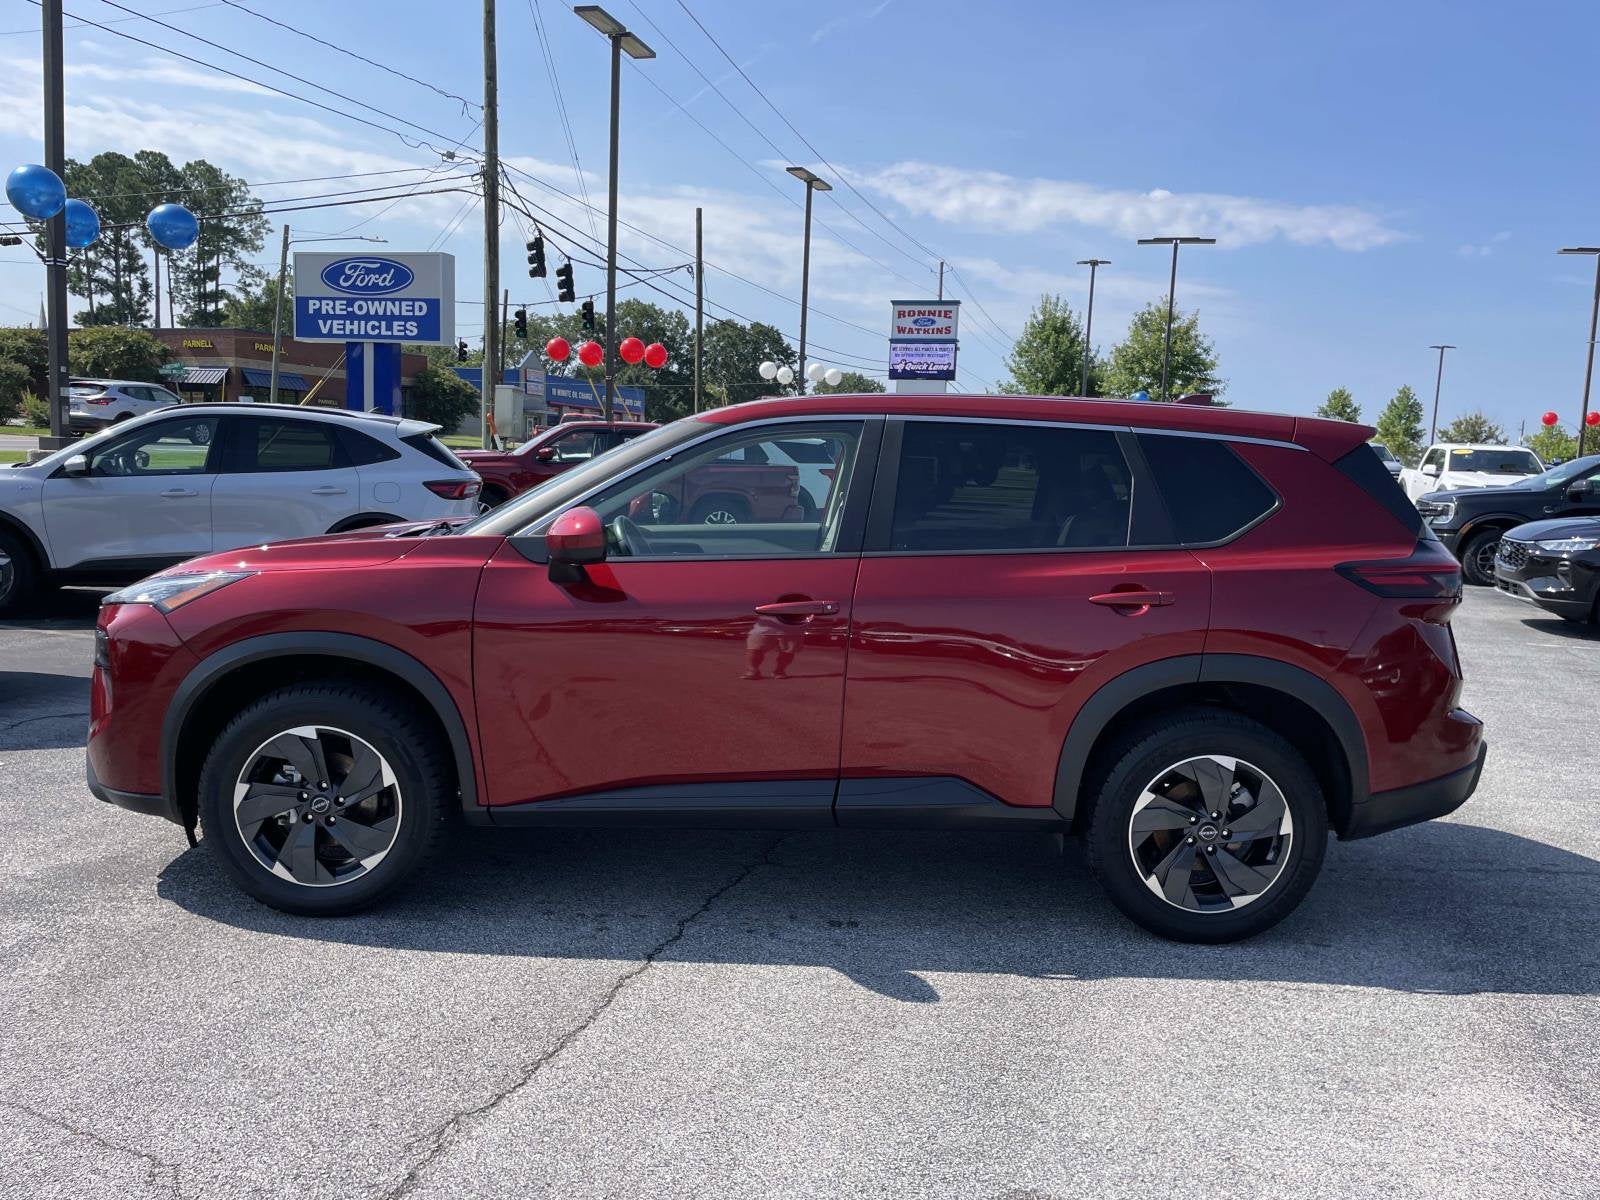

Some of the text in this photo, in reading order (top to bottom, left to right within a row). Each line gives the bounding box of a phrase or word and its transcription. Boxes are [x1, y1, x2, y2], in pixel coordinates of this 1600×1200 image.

[339, 262, 395, 287] Ford
[308, 299, 428, 316] PRE-OWNED
[897, 309, 953, 319] RONNIE
[318, 319, 419, 336] VEHICLES
[896, 326, 952, 335] WATKINS
[183, 339, 213, 348] PARNELL
[905, 362, 949, 370] Quick Lane
